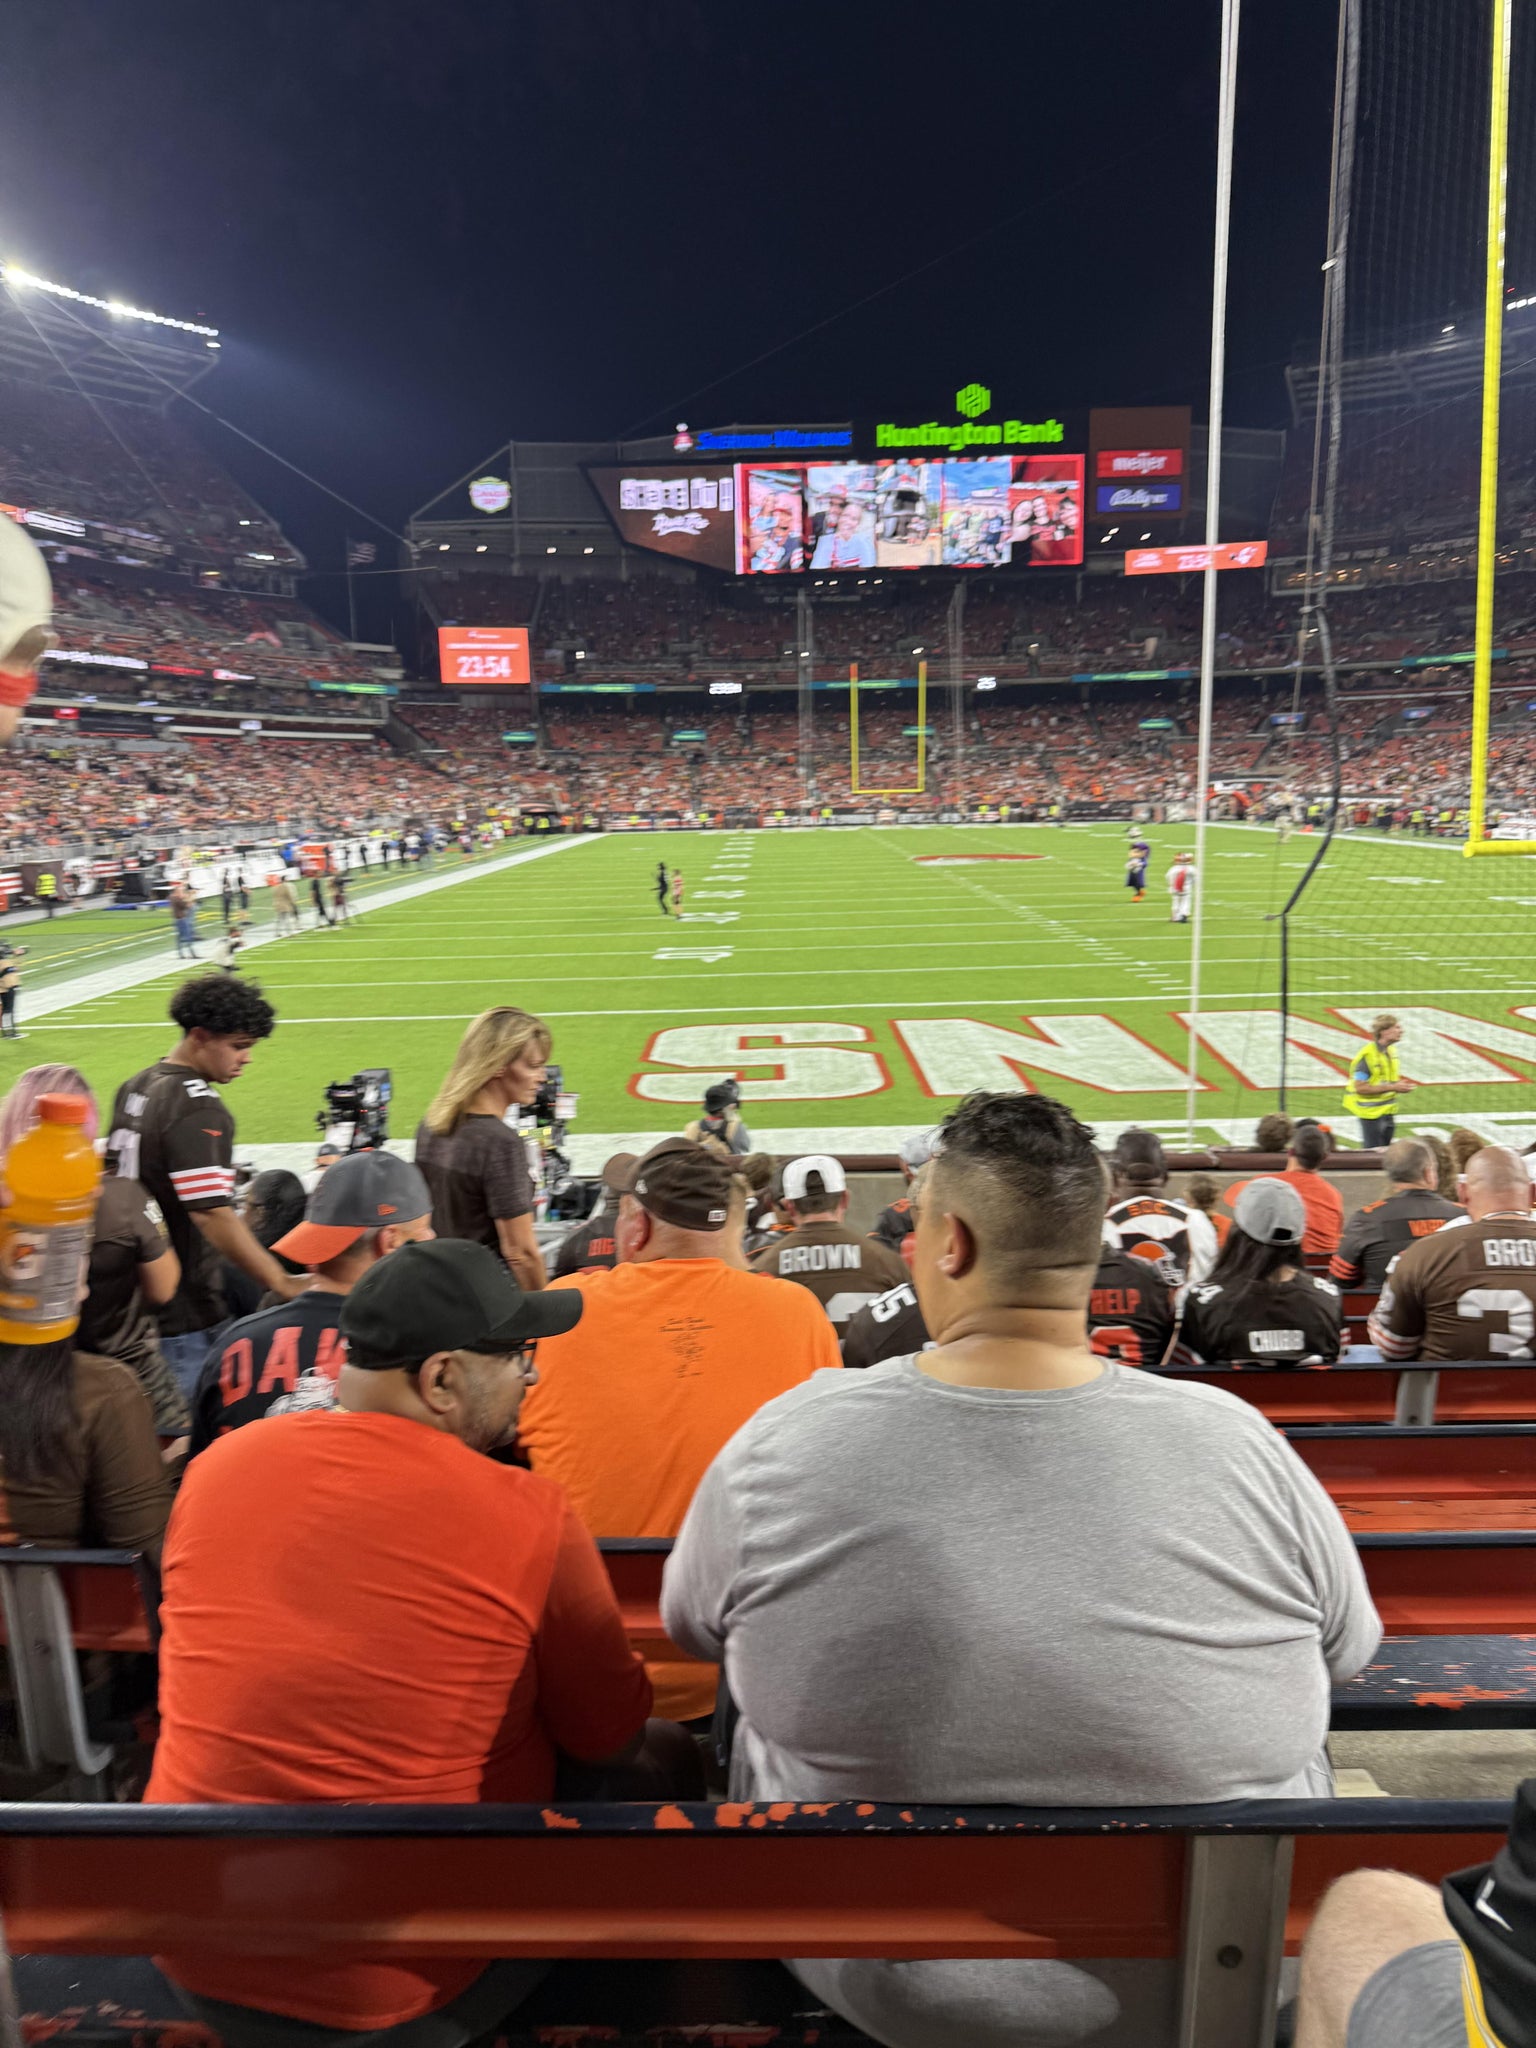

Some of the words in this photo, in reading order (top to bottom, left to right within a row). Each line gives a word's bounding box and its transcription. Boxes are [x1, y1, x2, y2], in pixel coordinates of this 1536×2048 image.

[876, 421, 1002, 451] Huntington
[1003, 419, 1064, 443] Bank
[1112, 452, 1168, 474] meijer
[456, 655, 512, 678] 23:54
[779, 1243, 861, 1275] BROWN
[218, 1326, 352, 1408] DAW
